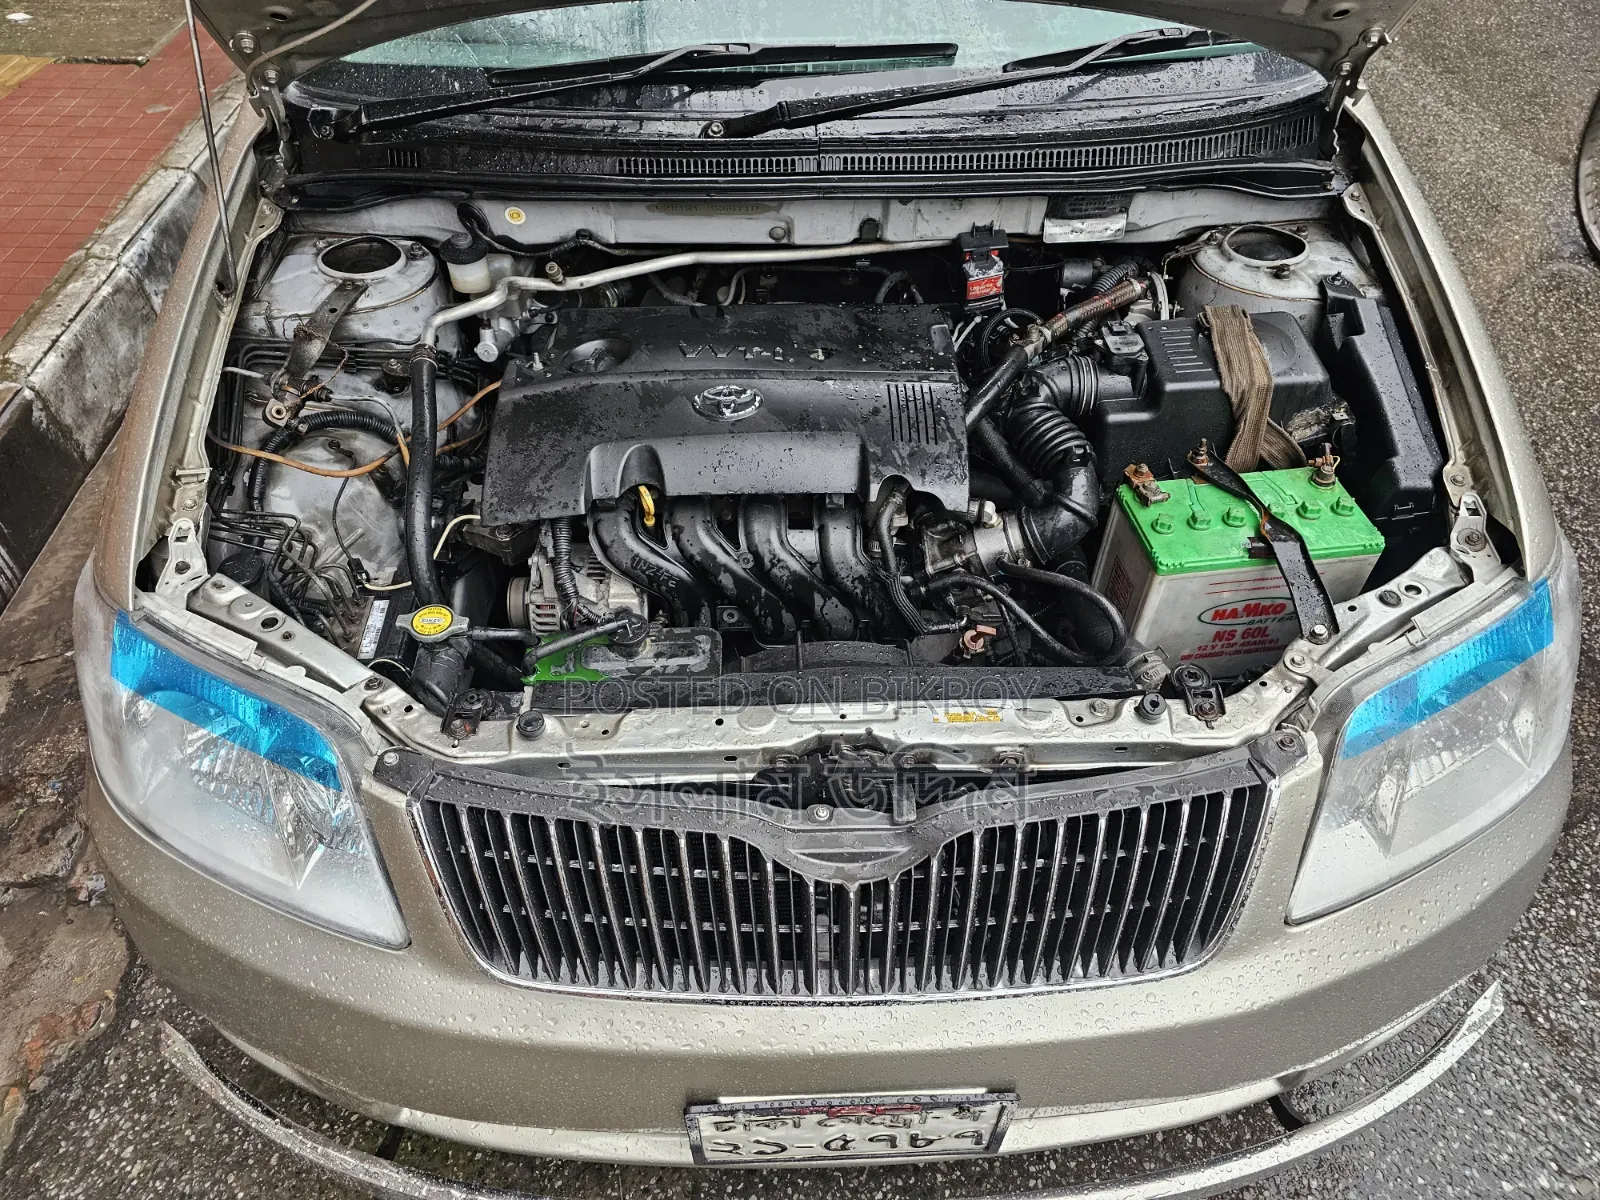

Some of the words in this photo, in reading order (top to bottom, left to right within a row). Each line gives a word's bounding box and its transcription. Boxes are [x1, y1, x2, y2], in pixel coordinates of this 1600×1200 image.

[631, 556, 680, 588] 1NZ-FE
[1211, 602, 1287, 621] HAMKO
[1212, 629, 1238, 643] NS
[1241, 626, 1271, 640] 60L
[1220, 642, 1238, 650] 13P
[1180, 653, 1194, 661] DRY
[1194, 650, 1226, 660] CHARGED
[712, 1116, 803, 1132] ঢাকা
